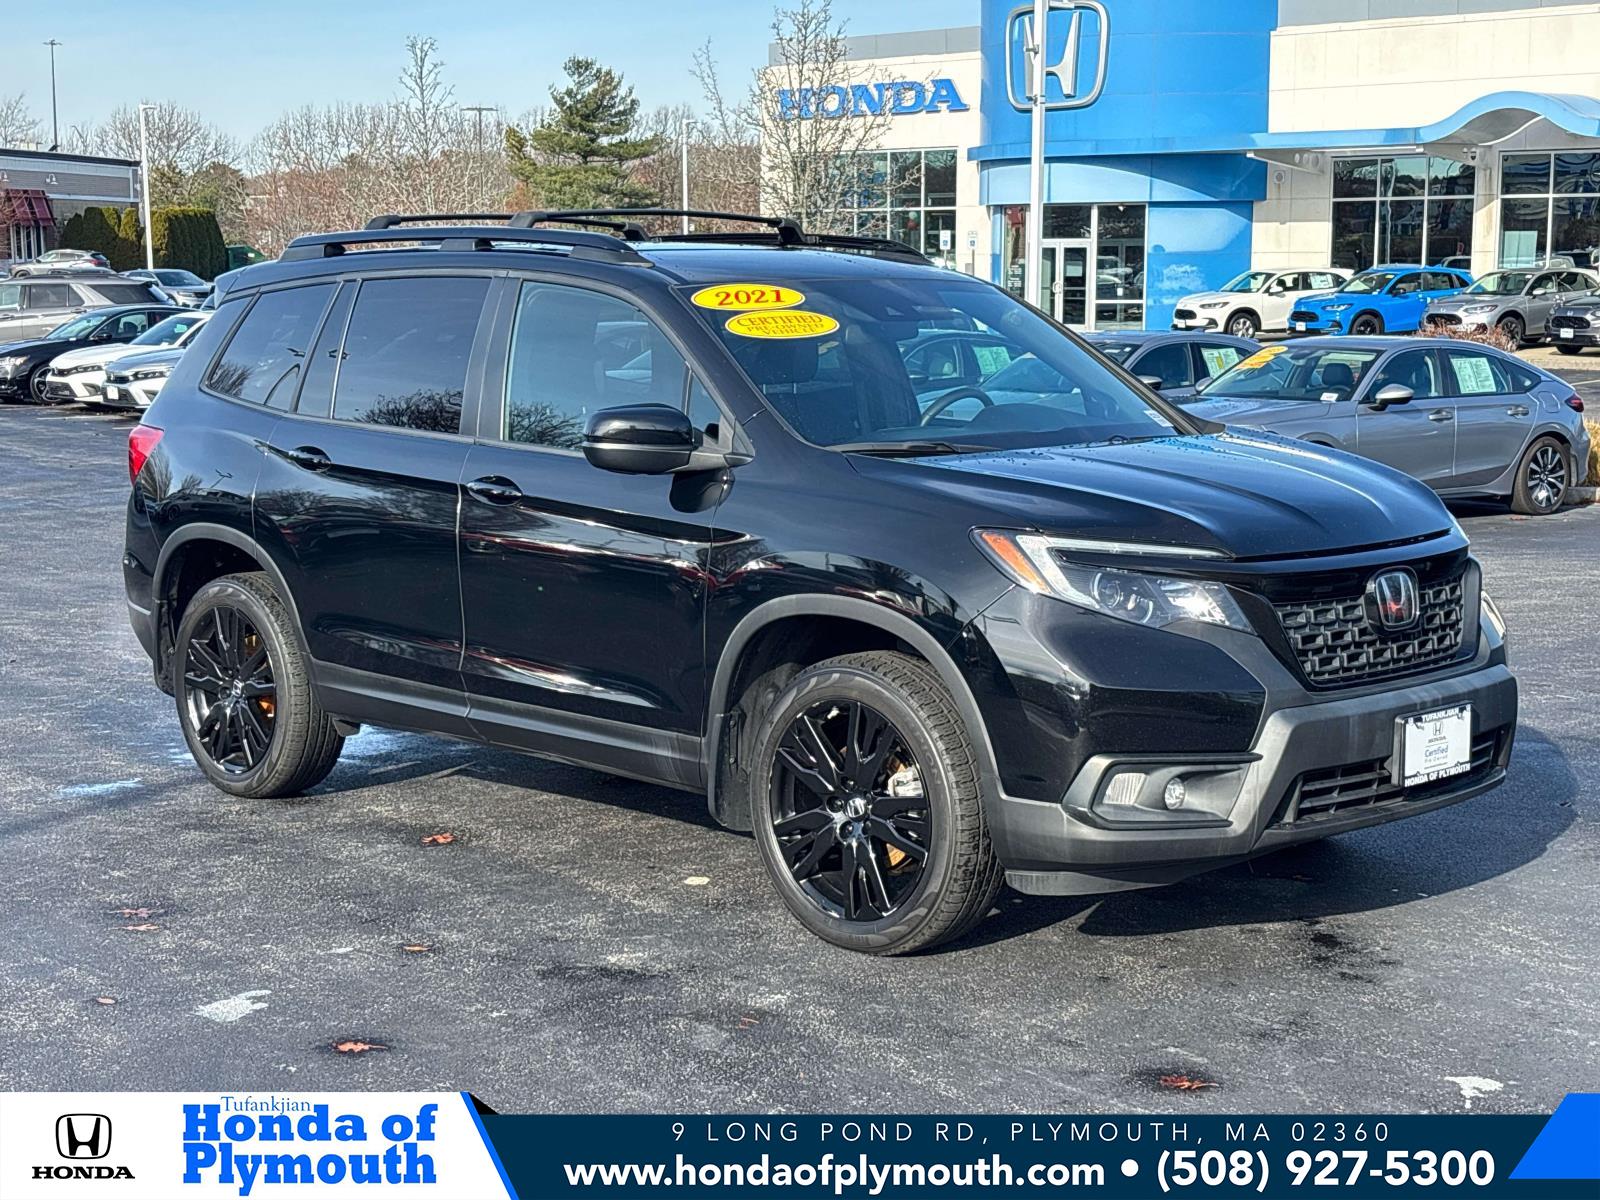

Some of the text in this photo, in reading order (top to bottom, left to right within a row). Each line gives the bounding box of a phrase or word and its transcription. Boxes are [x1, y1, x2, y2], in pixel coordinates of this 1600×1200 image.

[776, 78, 969, 120] HONDA
[715, 289, 785, 306] 2021
[737, 315, 822, 327] CERTIFIED
[1404, 763, 1471, 788] HONDA OF PLYMOUTH
